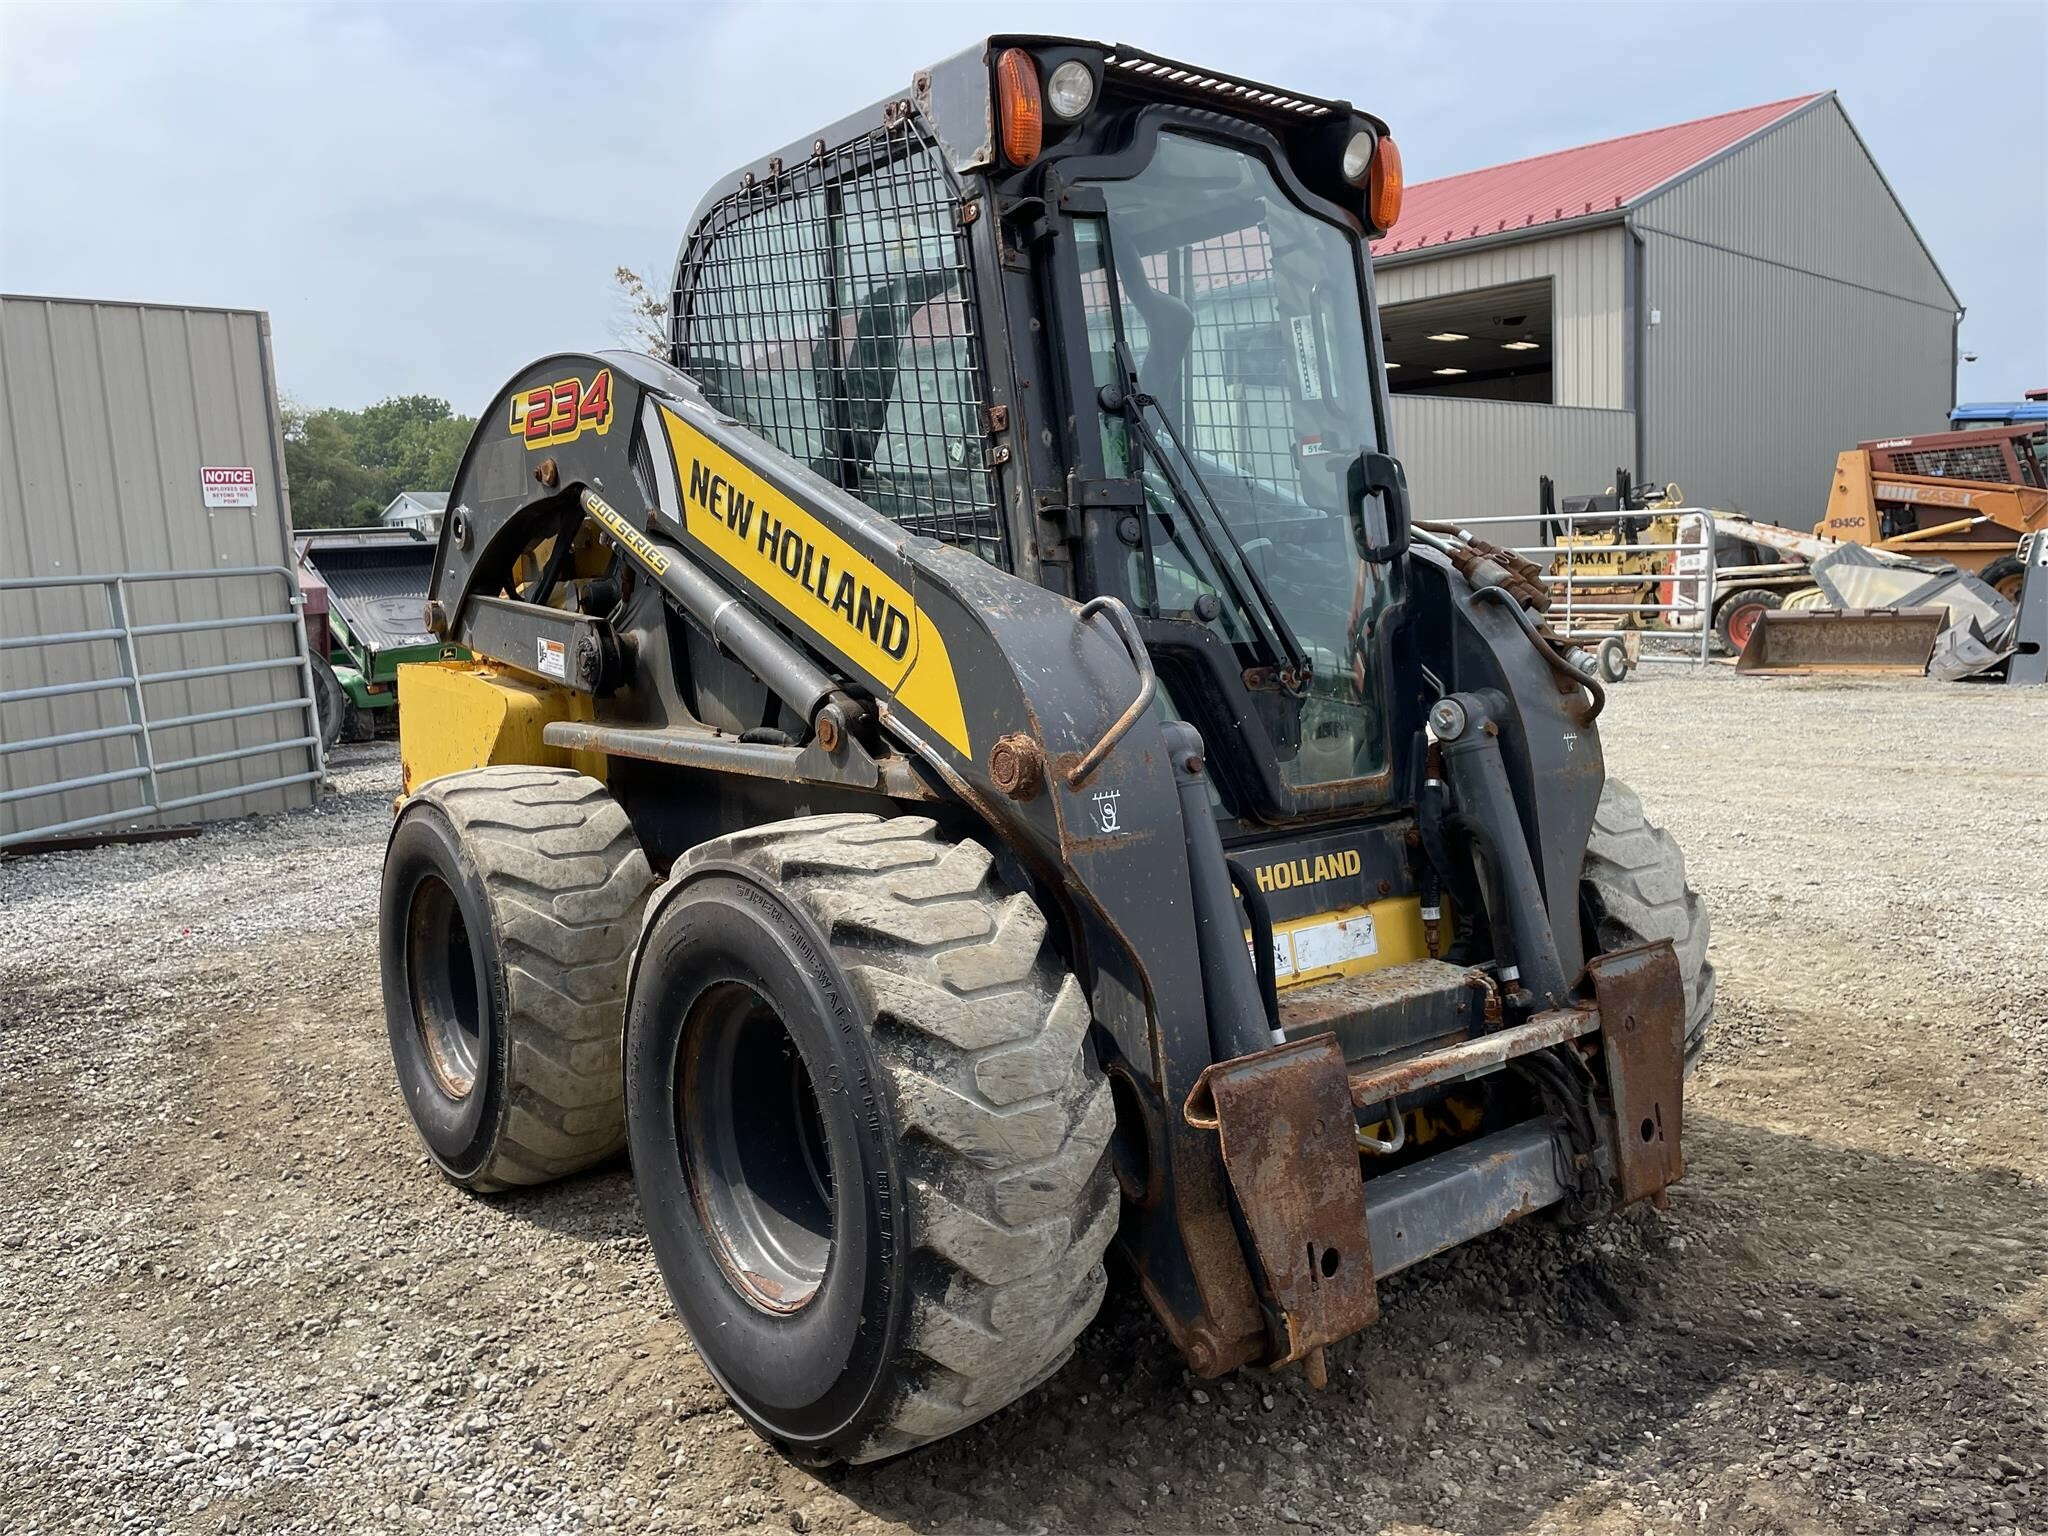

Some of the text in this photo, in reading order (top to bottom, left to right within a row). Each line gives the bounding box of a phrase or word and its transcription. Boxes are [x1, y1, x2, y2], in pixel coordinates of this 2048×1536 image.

[510, 371, 611, 443] L234
[1876, 438, 1913, 449] uni-loader
[205, 470, 251, 483] NOTICE
[1917, 488, 1965, 504] CASE
[587, 497, 669, 571] 200 SERIES
[1830, 516, 1865, 529] 1845C
[689, 458, 910, 662] NEW HOLLAND
[1255, 849, 1361, 893] HOLLAND
